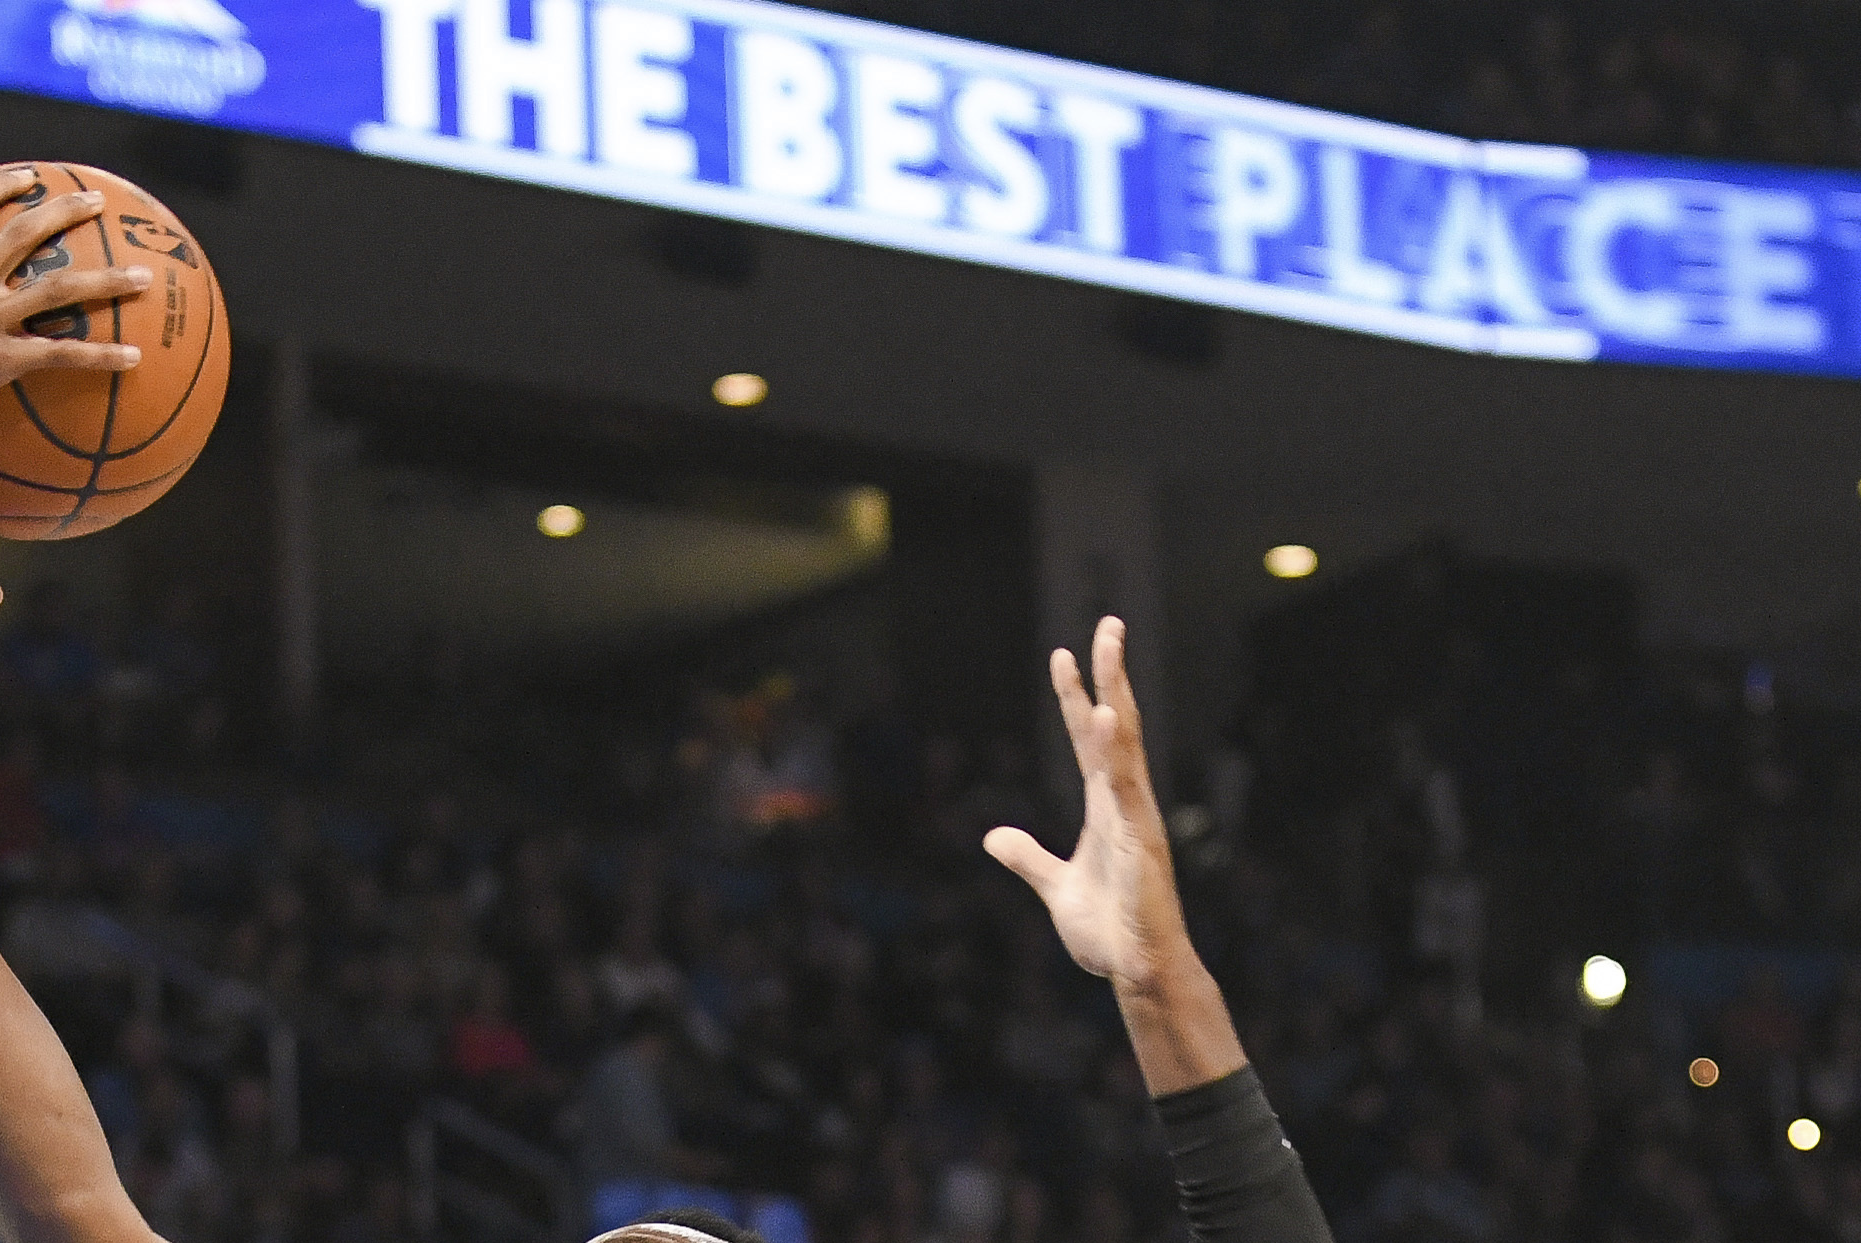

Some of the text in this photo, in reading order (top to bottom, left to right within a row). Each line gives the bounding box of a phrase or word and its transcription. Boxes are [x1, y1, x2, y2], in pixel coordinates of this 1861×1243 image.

[354, 0, 1826, 354] THE BEST PLACE
